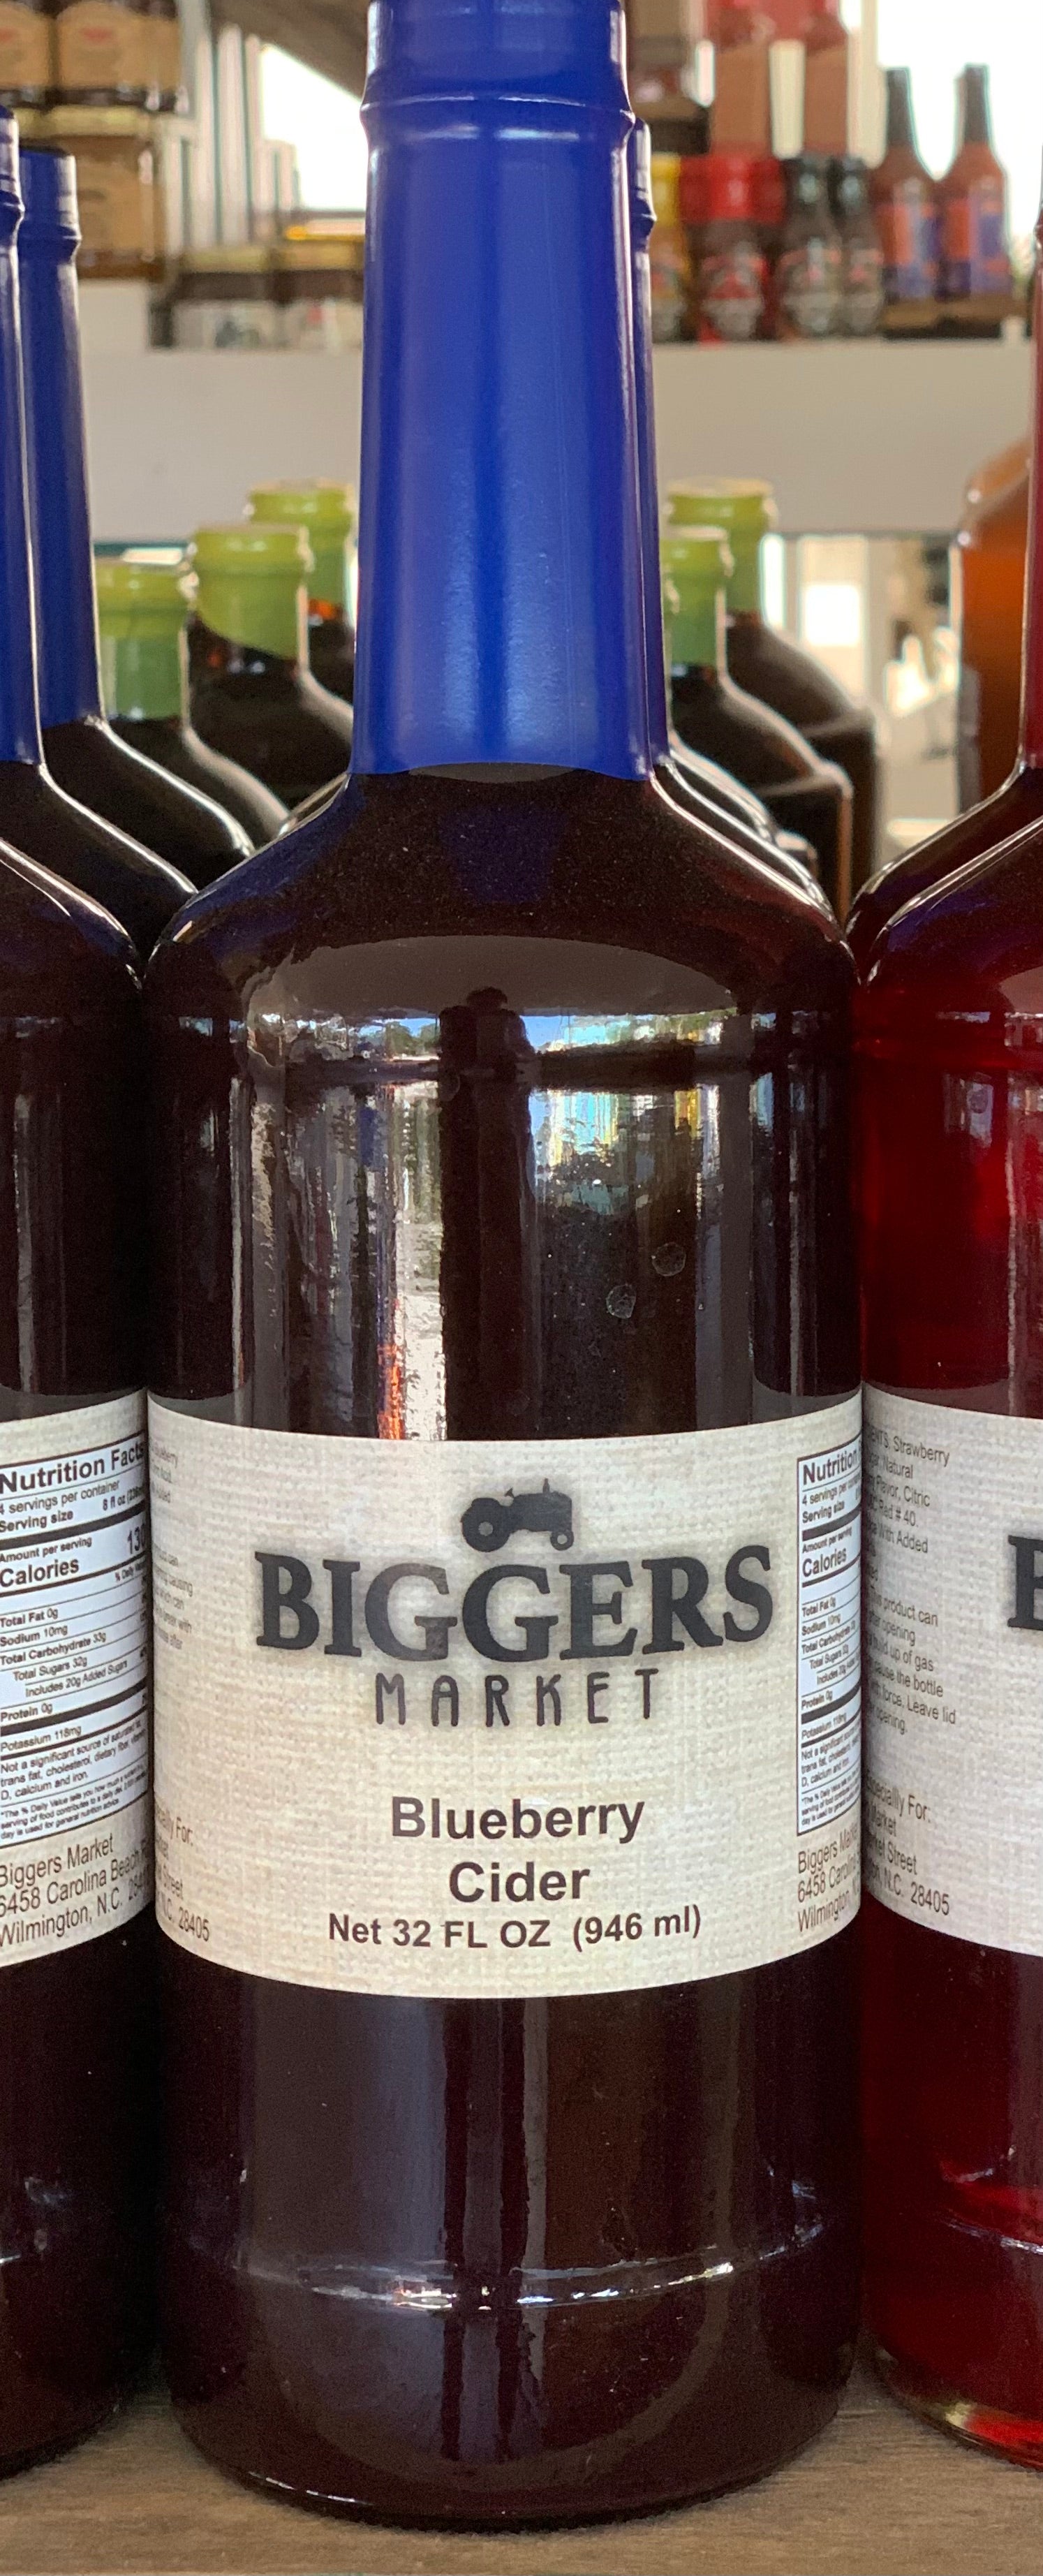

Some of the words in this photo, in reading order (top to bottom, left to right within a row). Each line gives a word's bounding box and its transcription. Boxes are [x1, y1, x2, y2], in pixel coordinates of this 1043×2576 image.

[893, 1435, 949, 1467] Strawberry
[0, 1458, 105, 1494] Nutrition
[803, 1449, 857, 1486] Nutrition
[9, 1496, 58, 1514] servings
[61, 1490, 77, 1506] per
[80, 1480, 120, 1499] container
[802, 1494, 808, 1506] 4
[810, 1487, 838, 1505] servings
[903, 1485, 930, 1507] Citric
[0, 1514, 47, 1533] Serving
[51, 1510, 73, 1523] size
[103, 1499, 108, 1511] 8
[802, 1505, 831, 1524] Serving
[903, 1509, 919, 1528] 40.
[0, 1549, 40, 1563] Amount
[43, 1545, 57, 1557] per
[61, 1536, 92, 1552] serving
[802, 1538, 827, 1554] Amount
[896, 1530, 929, 1553] Added
[0, 1559, 80, 1587] Calories
[802, 1547, 847, 1577] Calories
[1, 1614, 26, 1628] Total
[29, 1612, 45, 1623] Fat
[47, 1608, 59, 1619] 0g
[255, 1545, 773, 1662] BIGGERS
[801, 1603, 818, 1617] Total
[884, 1597, 916, 1621] product
[918, 1610, 938, 1627] can
[0, 1633, 40, 1647] Sodium
[44, 1626, 68, 1637] 10mg
[801, 1621, 827, 1636] Sodium
[1, 1652, 26, 1665] Total
[29, 1637, 91, 1660] Carbohydrate
[801, 1640, 818, 1654] Total
[890, 1645, 901, 1663] up
[903, 1649, 912, 1665] of
[915, 1655, 934, 1672] gas
[13, 1668, 36, 1681] Total
[39, 1662, 70, 1677] Sugars
[73, 1656, 87, 1668] 32g
[26, 1681, 64, 1698] Includes
[66, 1676, 81, 1688] 20g
[82, 1670, 105, 1684] Added
[376, 1668, 659, 1728] MARKET
[897, 1669, 910, 1688] the
[913, 1674, 943, 1698] bottle
[0, 1707, 38, 1722] Protein
[40, 1702, 53, 1714] 0g
[801, 1694, 824, 1710] Protein
[907, 1694, 939, 1720] Leave
[942, 1705, 956, 1724] lid
[0, 1734, 51, 1751] Potassium
[54, 1725, 82, 1740] 118mg
[1, 1762, 18, 1774] Not
[22, 1761, 27, 1769] a
[30, 1748, 74, 1767] significant
[76, 1739, 101, 1755] source
[801, 1749, 813, 1761] Not
[1, 1775, 26, 1787] trans
[29, 1769, 43, 1780] fat,
[46, 1755, 92, 1776] cholesterol,
[1, 1790, 12, 1800] D,
[15, 1781, 52, 1797] calcium
[54, 1776, 70, 1788] and
[1, 1817, 28, 1830] serving
[39, 1810, 54, 1820] food
[392, 1796, 645, 1843] Blueberry
[908, 1793, 931, 1823] For:
[1, 1830, 14, 1840] day
[25, 1823, 43, 1834] used
[45, 1820, 54, 1830] for
[56, 1813, 79, 1828] general
[0, 1856, 61, 1890] Biggers
[67, 1832, 113, 1869] Market
[798, 1840, 837, 1874] Biggers
[887, 1841, 917, 1876] Street
[0, 1886, 40, 1918] 6458
[47, 1869, 107, 1904] Carolina
[449, 1861, 591, 1903] Cider
[797, 1871, 825, 1903] 6458
[910, 1881, 949, 1916] 28405
[0, 1904, 92, 1948] Wilmington,
[97, 1887, 123, 1917] N.C.
[179, 1906, 209, 1941] 28405
[329, 1913, 382, 1945] Net
[392, 1918, 431, 1946] 32
[444, 1920, 488, 1948] FL
[500, 1920, 551, 1948] OZ
[573, 1912, 643, 1952] (946
[654, 1904, 701, 1939] ml)
